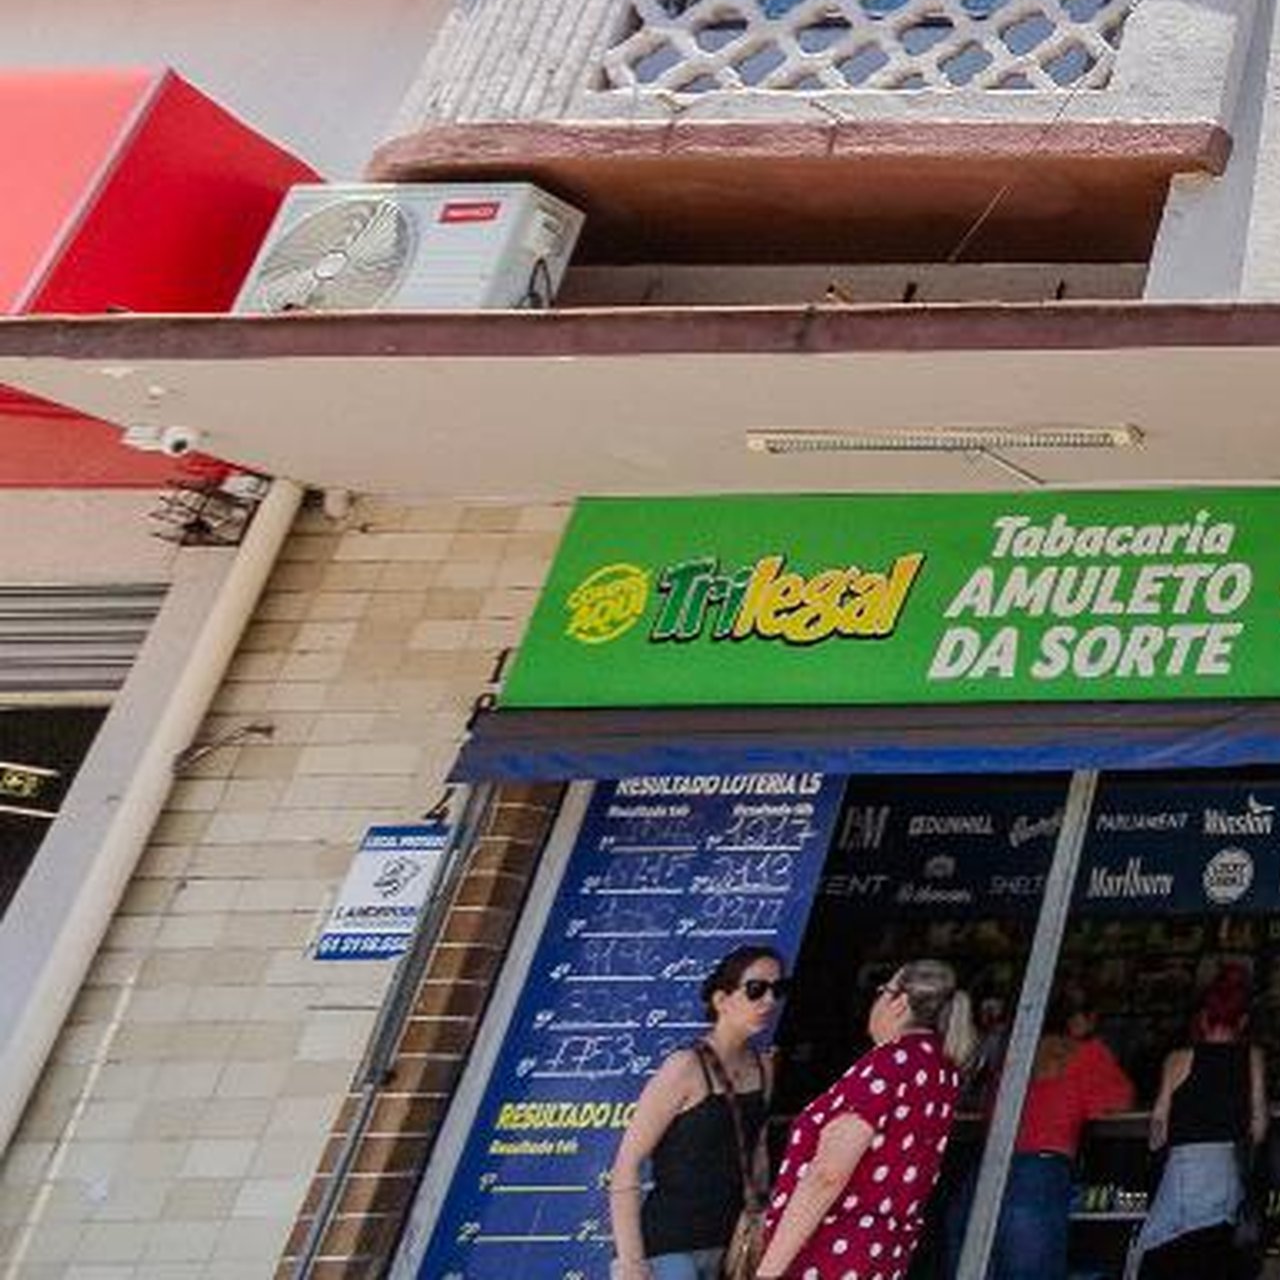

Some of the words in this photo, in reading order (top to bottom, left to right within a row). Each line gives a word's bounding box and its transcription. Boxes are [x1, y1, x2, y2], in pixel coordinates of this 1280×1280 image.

[992, 509, 1236, 558] Tabacaria
[652, 553, 926, 644] Trilegal
[943, 562, 1252, 618] AMULETO
[927, 626, 1018, 680] DA
[1030, 622, 1244, 679] SORTE
[615, 776, 717, 796] RESULTADO
[718, 773, 796, 795] LOTERIA
[824, 874, 889, 895] ENT
[1087, 855, 1175, 898] Marlboro
[495, 1102, 607, 1130] RESULTADO
